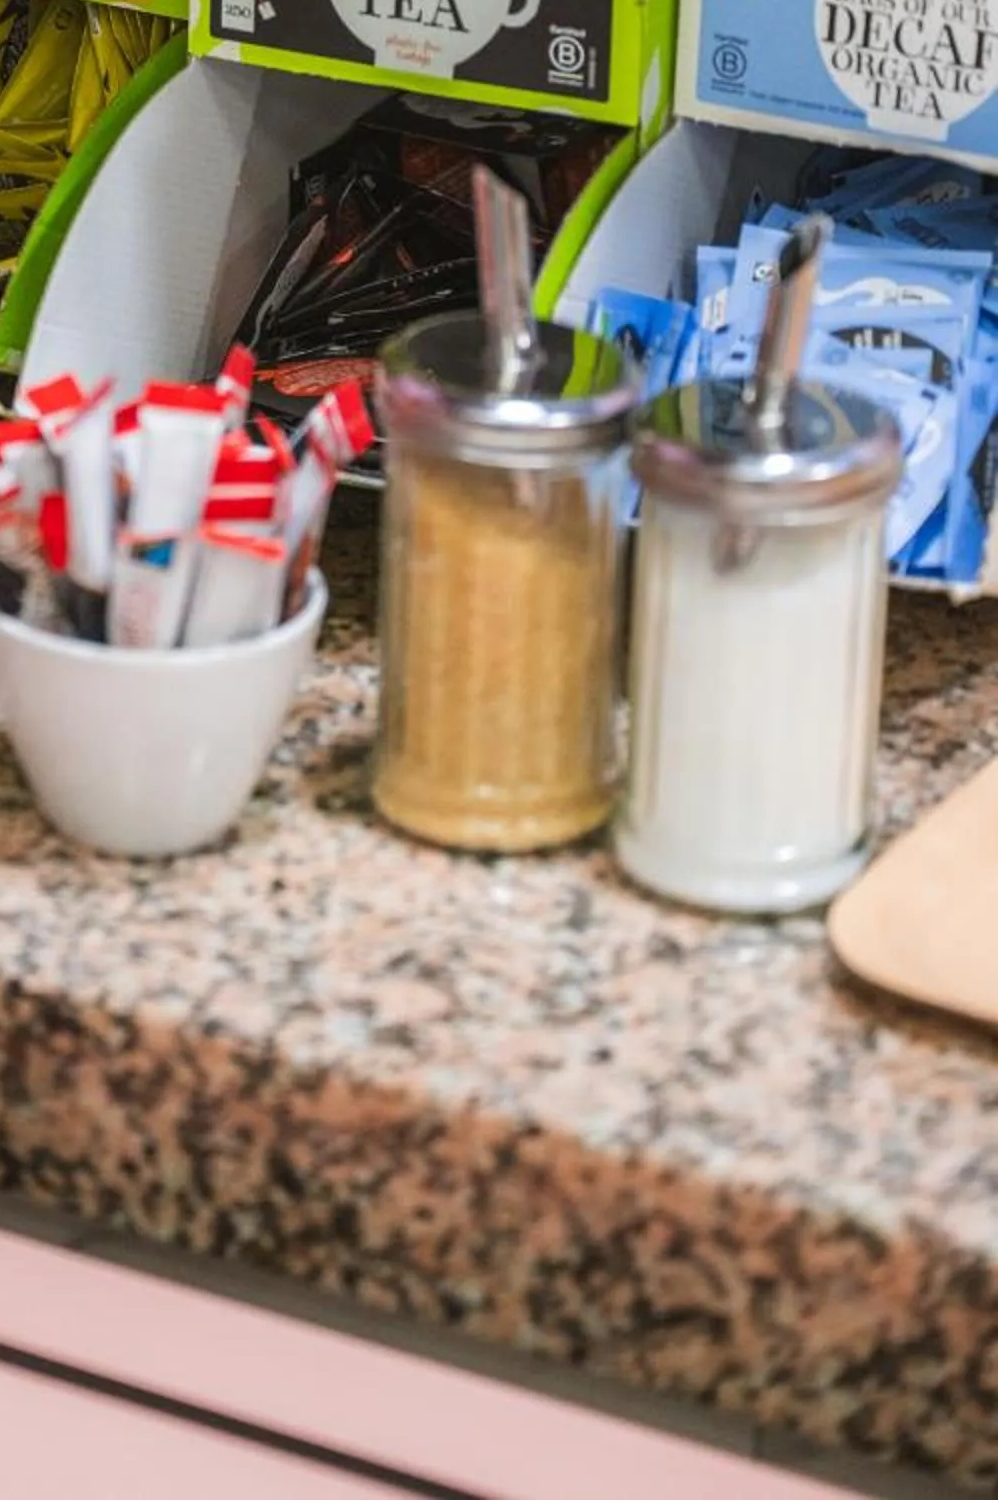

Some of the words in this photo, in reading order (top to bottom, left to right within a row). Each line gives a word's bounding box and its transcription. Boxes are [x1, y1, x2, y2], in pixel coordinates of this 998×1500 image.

[821, 1, 998, 70] DECAF
[941, 1, 990, 27] OUR
[830, 48, 985, 95] ORGANIC
[866, 80, 944, 121] TEA
